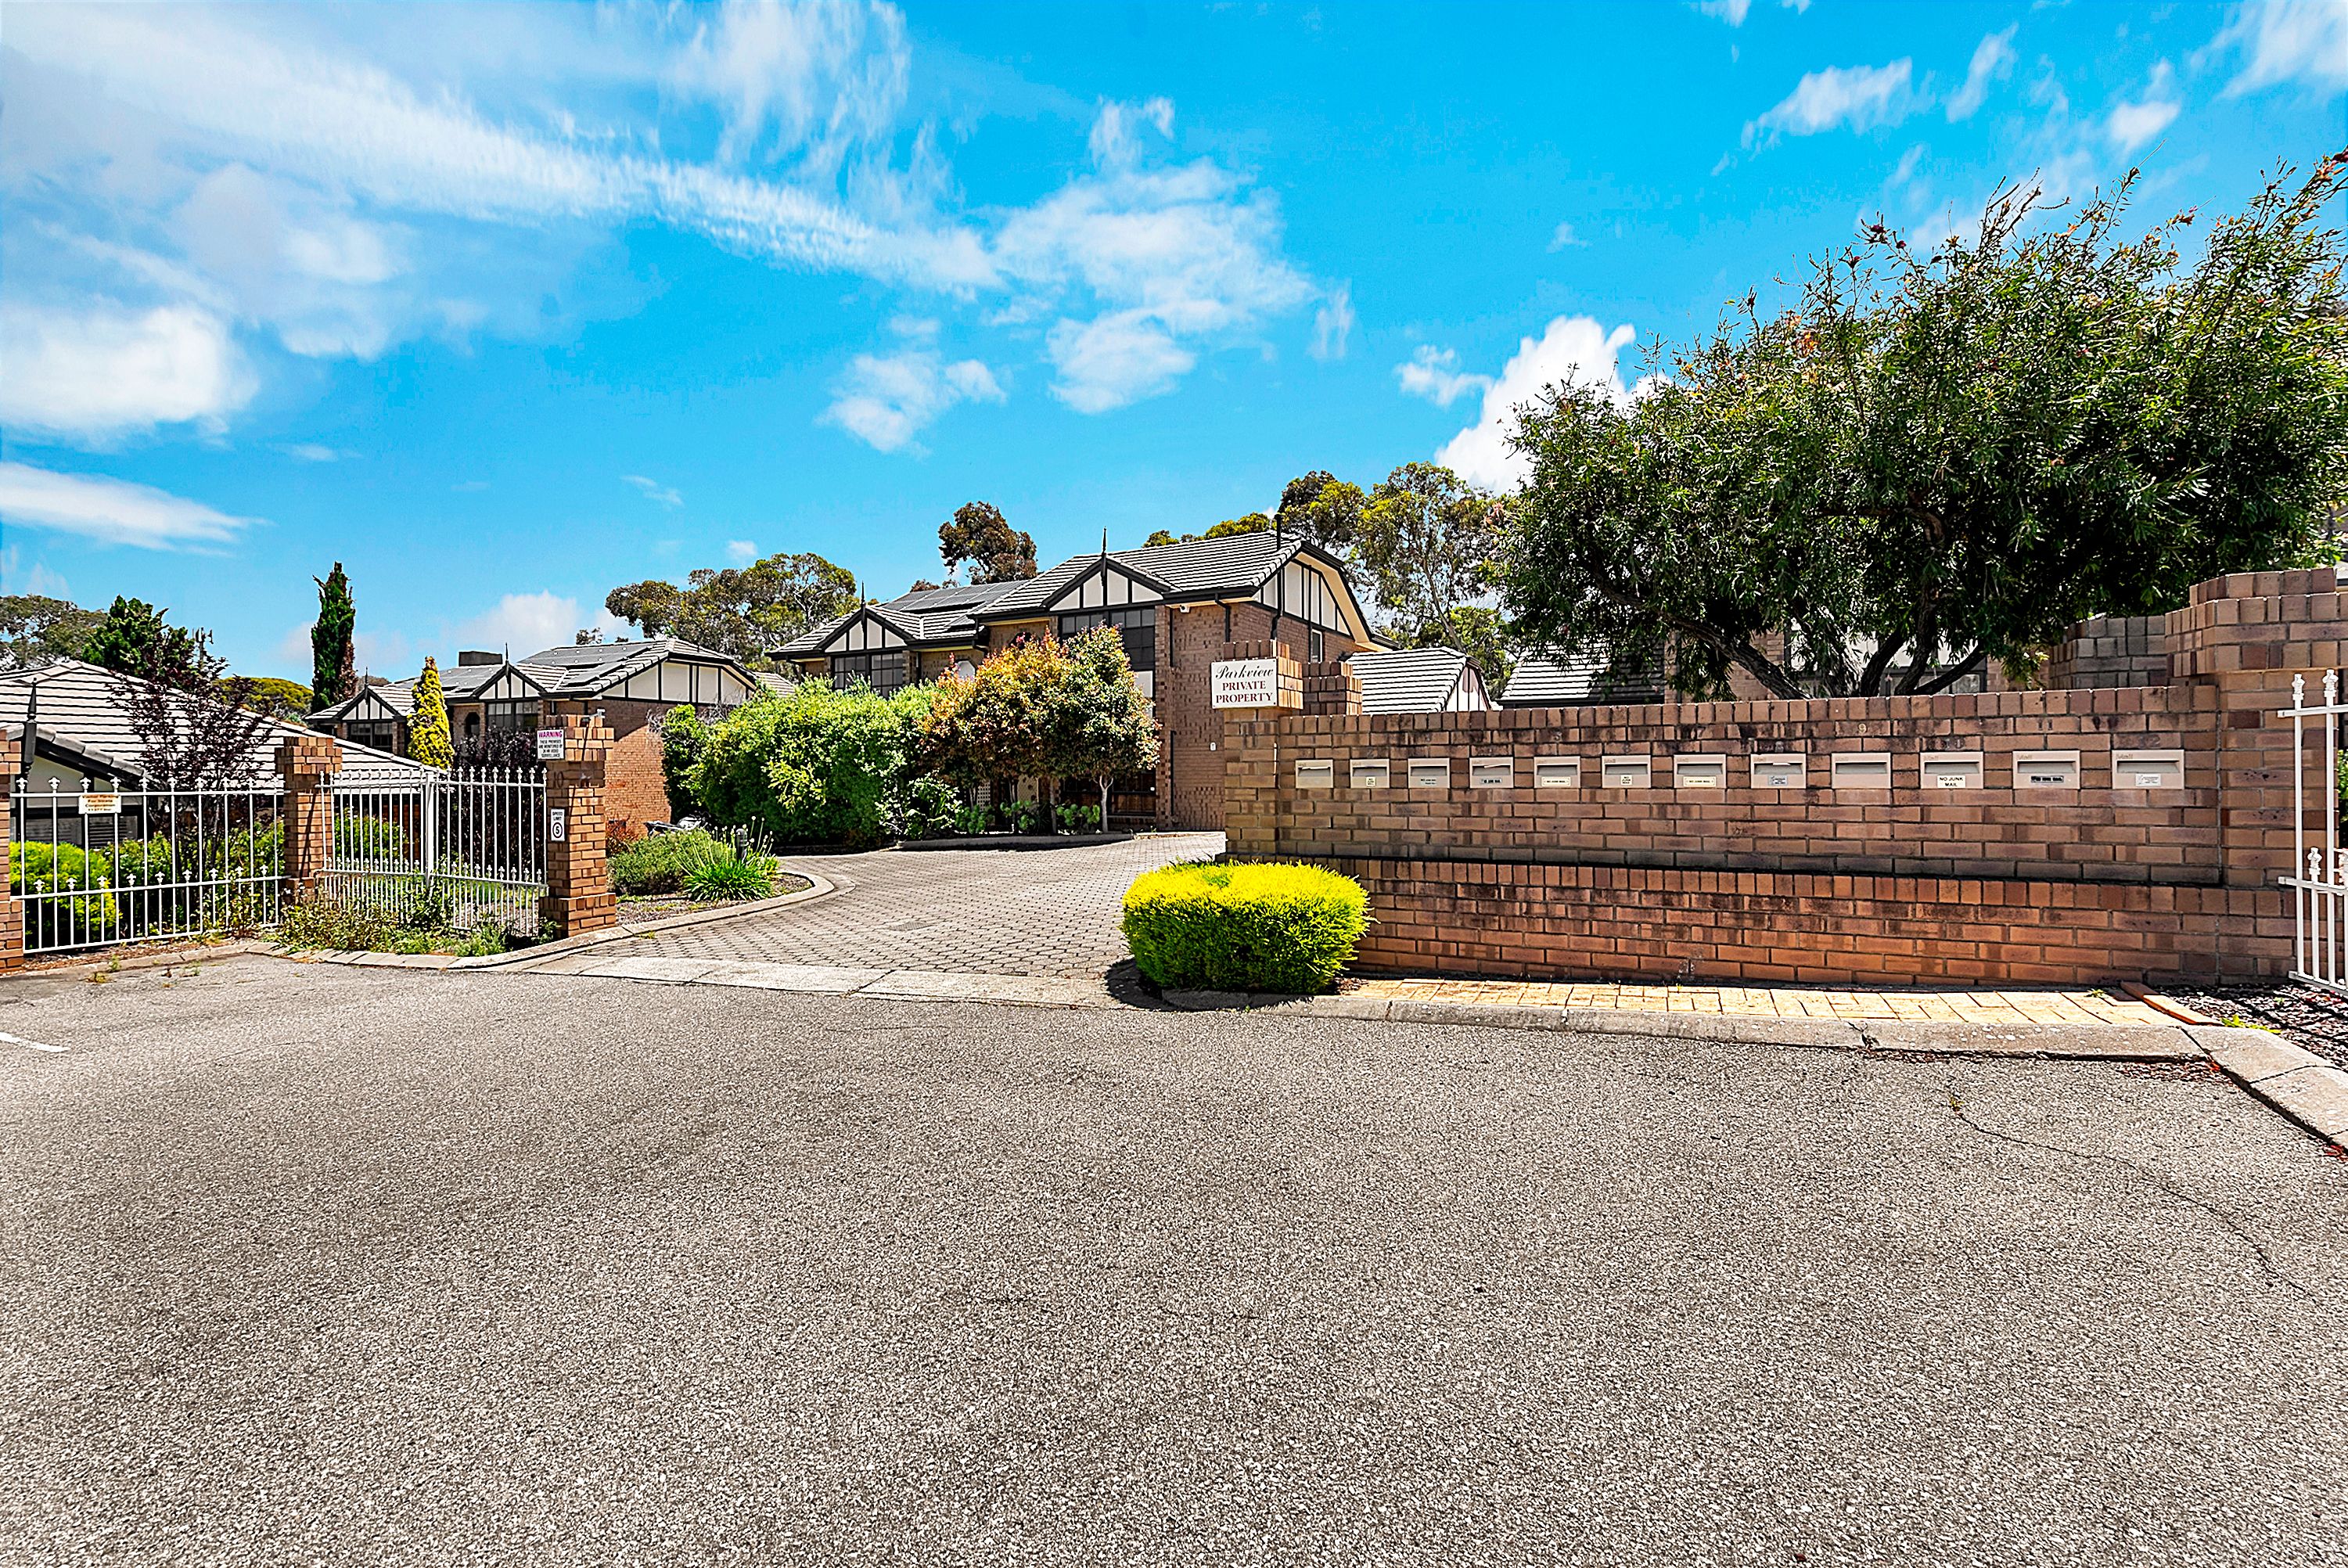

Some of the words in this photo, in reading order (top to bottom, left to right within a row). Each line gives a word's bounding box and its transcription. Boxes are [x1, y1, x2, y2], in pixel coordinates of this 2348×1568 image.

[1215, 664, 1274, 679] Parkview
[1222, 681, 1267, 691] PRIVATE
[1216, 692, 1273, 703] PROPERTY
[1858, 723, 1867, 734] 9
[556, 825, 560, 835] 5
